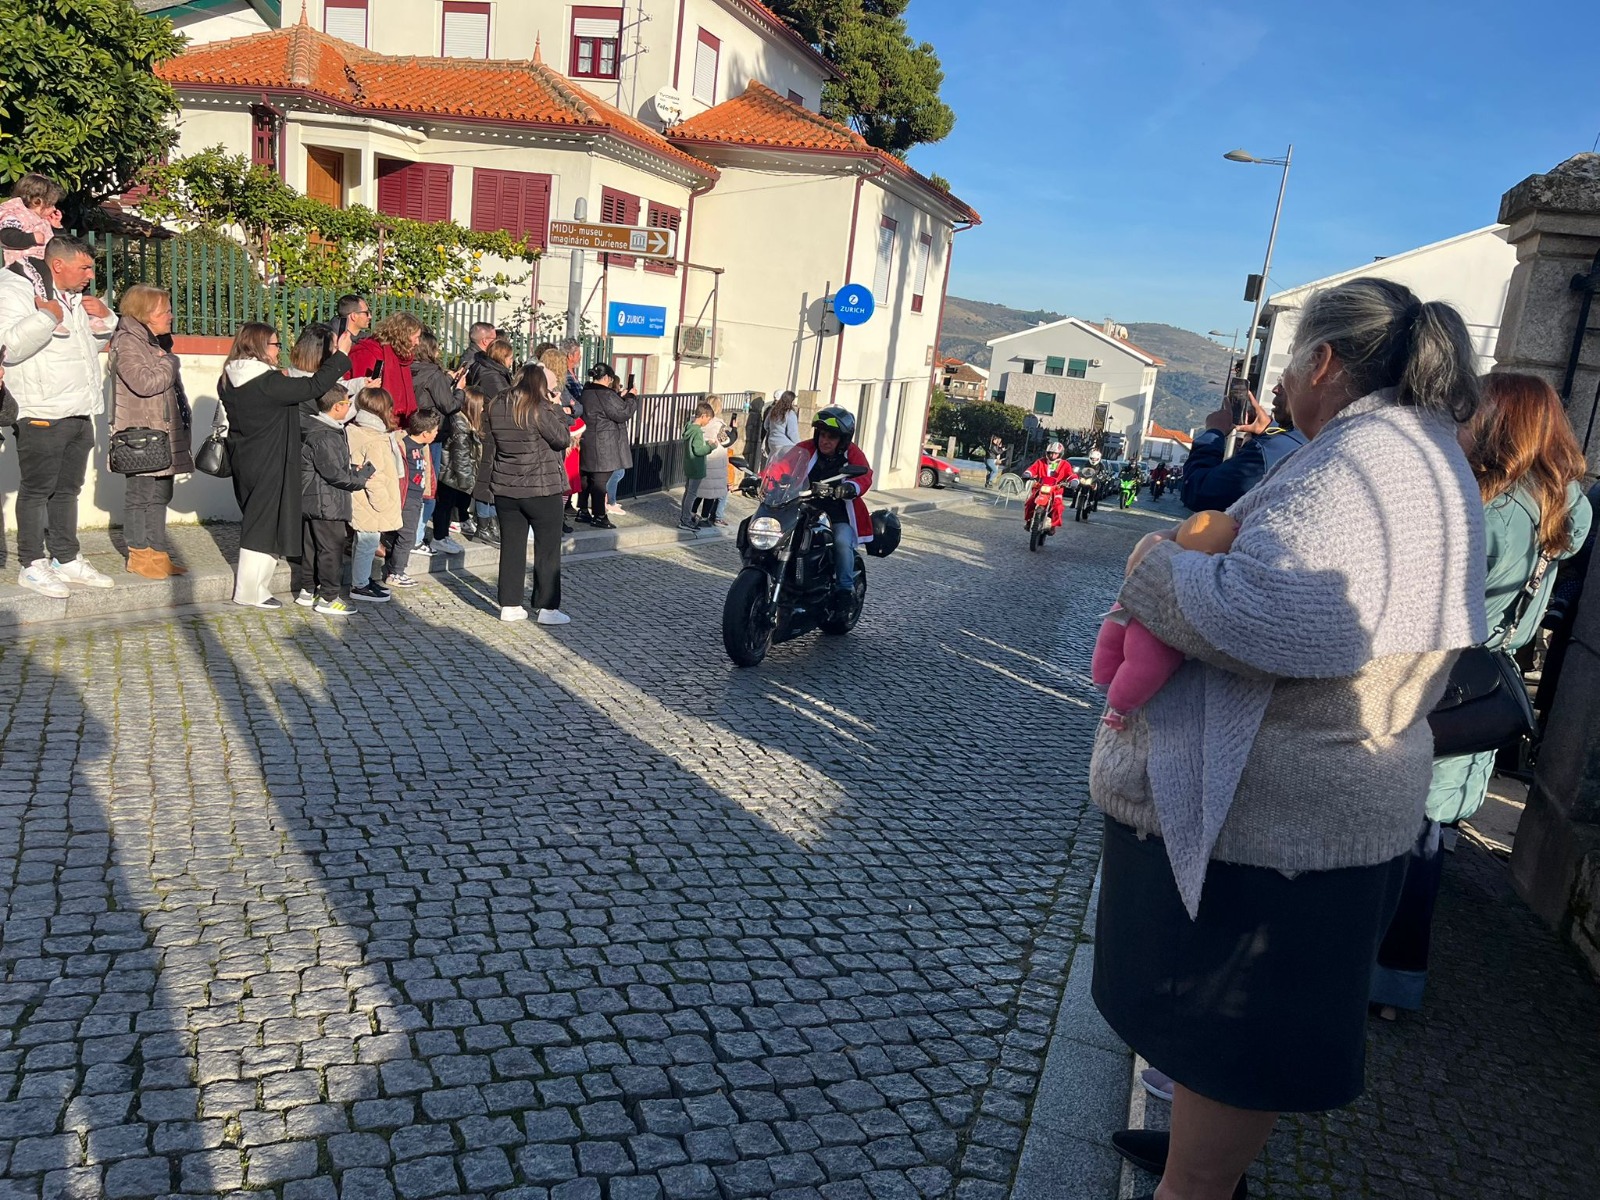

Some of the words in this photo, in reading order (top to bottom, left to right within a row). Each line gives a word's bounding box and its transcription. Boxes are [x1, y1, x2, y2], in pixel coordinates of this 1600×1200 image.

[551, 223, 577, 234] MIDU-
[578, 227, 603, 237] museu
[550, 233, 590, 246] imaginário
[594, 238, 628, 249] Duriense
[840, 306, 865, 314] ZURICH
[626, 314, 645, 325] ZURICH
